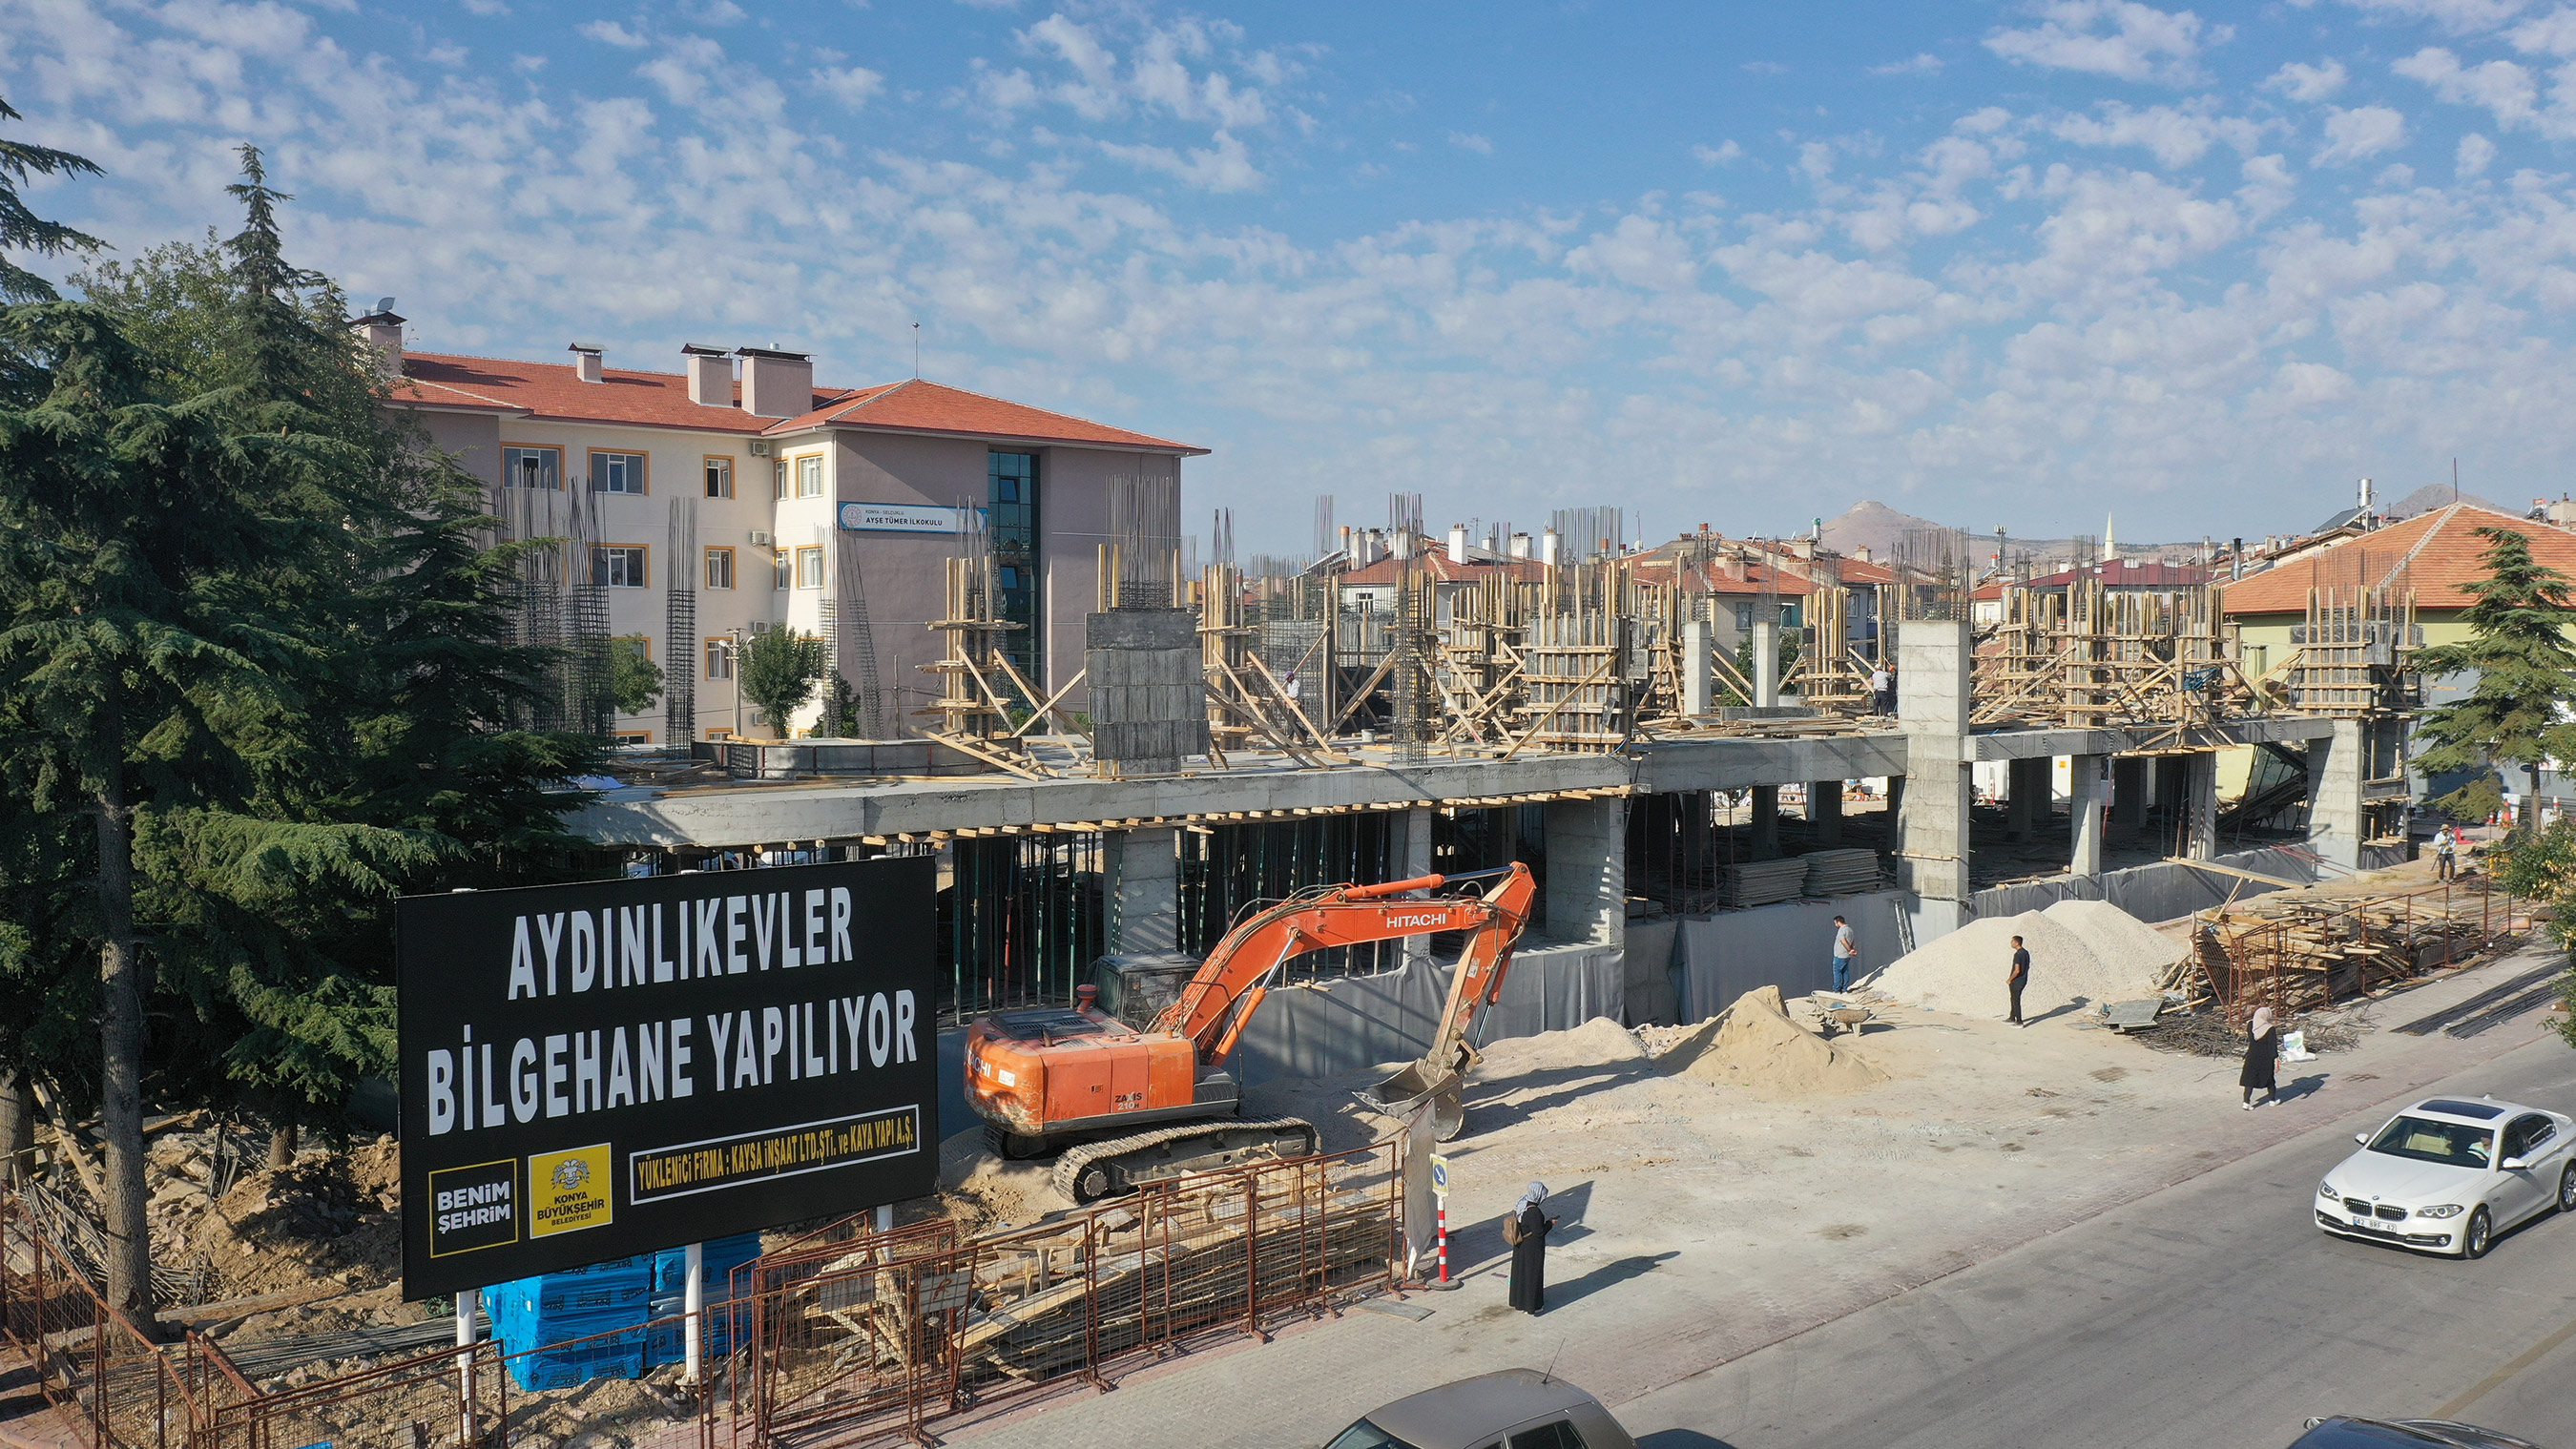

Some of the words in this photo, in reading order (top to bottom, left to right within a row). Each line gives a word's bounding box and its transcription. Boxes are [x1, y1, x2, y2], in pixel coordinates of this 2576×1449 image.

[884, 516, 908, 526] TÜMER
[909, 517, 943, 526] İLKOKULU
[1386, 914, 1446, 928] HITACHI
[509, 887, 852, 1000] AYDINLIKEVLER
[428, 1018, 693, 1136] BİLGEHANE
[707, 990, 917, 1092] YAPILIYOR
[1114, 1091, 1143, 1104] ZAXIS
[732, 1142, 763, 1174] KAYSA
[838, 1133, 849, 1154] ve
[850, 1123, 873, 1153] KAYA
[875, 1119, 895, 1148] YAPI
[896, 1115, 913, 1149] A.Ş.
[554, 1191, 589, 1205] KONYA
[537, 1198, 605, 1220] BÜYÜKŞEHİR
[551, 1212, 592, 1227] BELEDİYESİ
